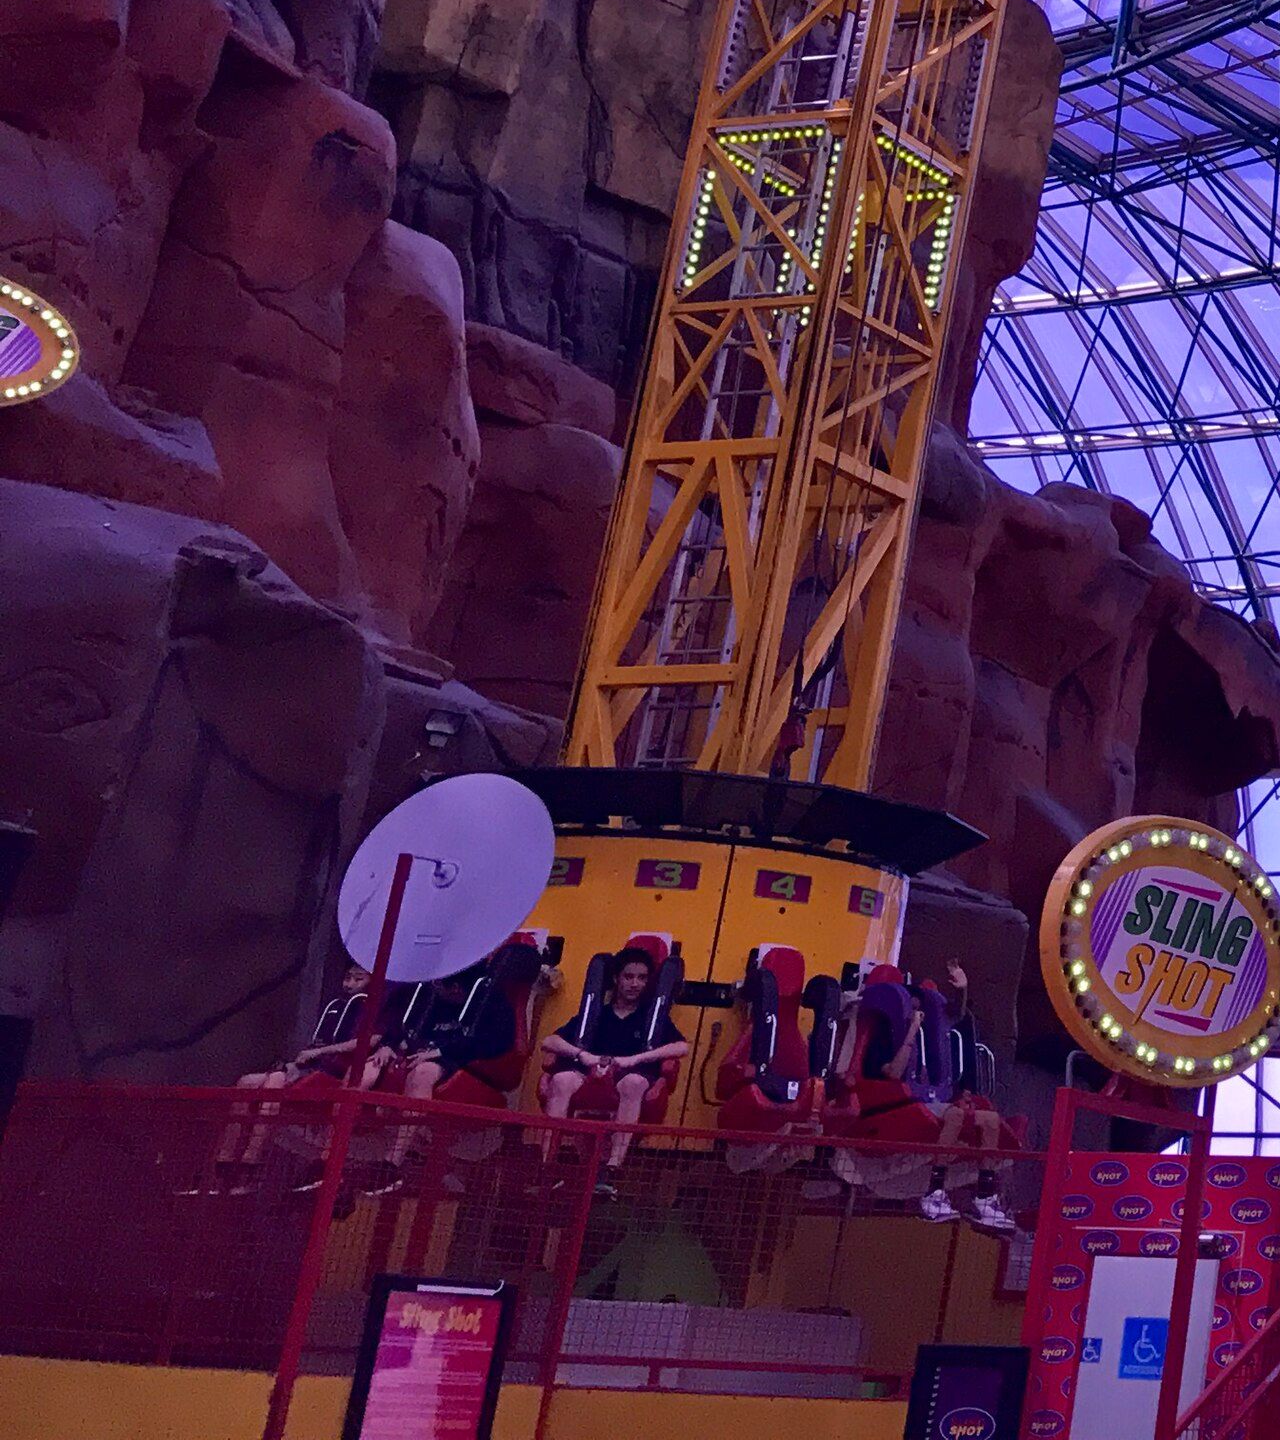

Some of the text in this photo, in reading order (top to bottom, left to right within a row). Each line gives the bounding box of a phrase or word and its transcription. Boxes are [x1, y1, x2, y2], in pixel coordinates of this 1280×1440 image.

[652, 862, 684, 887] 3
[770, 874, 797, 900] 4
[859, 893, 876, 915] 5
[1123, 885, 1253, 966] SLING
[1114, 943, 1235, 1025] SHOT
[1096, 1171, 1121, 1182] SHOT
[1154, 1172, 1180, 1184] SHOT
[1213, 1173, 1239, 1184] SHOT
[1119, 1206, 1145, 1218] SHOT
[1237, 1209, 1263, 1221] SHOT
[1087, 1241, 1112, 1253] SHOT
[1146, 1242, 1172, 1254] SHOT
[949, 1425, 985, 1440] SHOT
